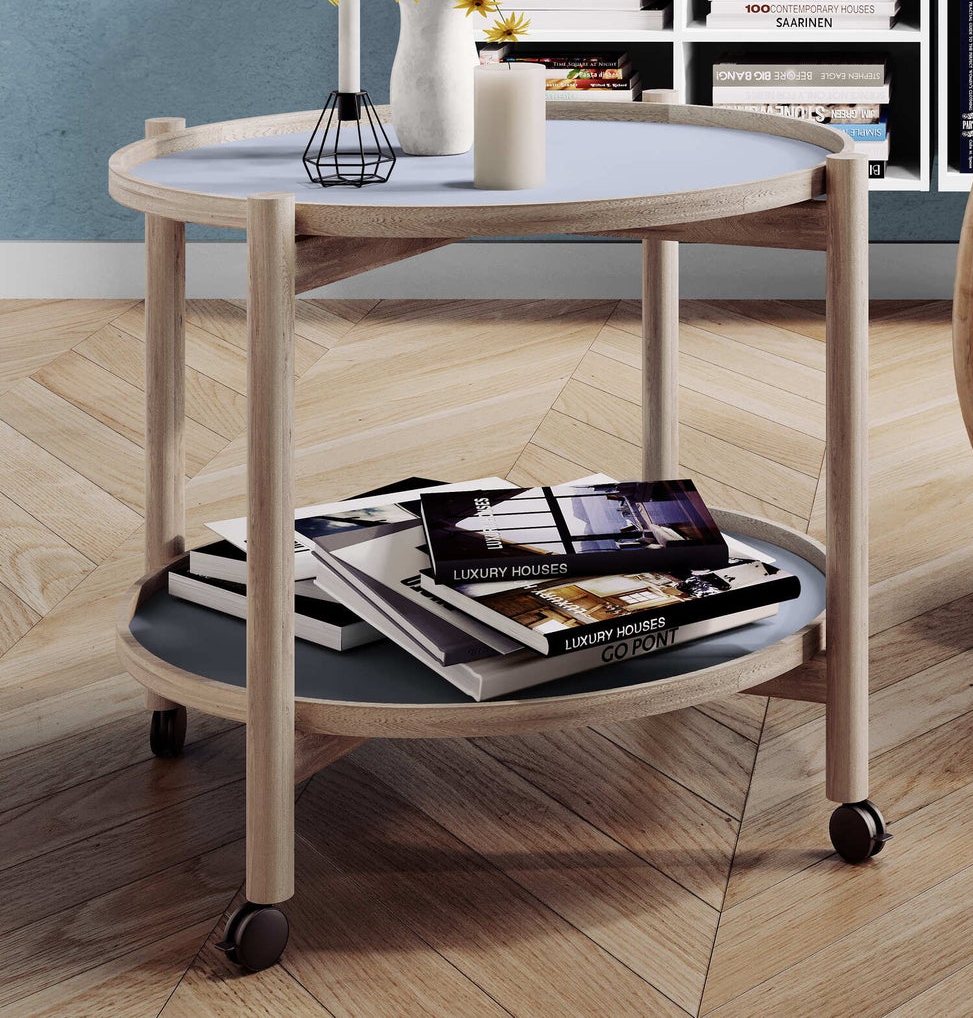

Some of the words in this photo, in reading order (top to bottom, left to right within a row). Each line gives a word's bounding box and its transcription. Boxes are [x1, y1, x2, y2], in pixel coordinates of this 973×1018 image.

[841, 5, 875, 14] HOUSES
[776, 17, 833, 27] SAARINEN
[717, 71, 752, 81] BANG!
[754, 71, 771, 81] BIG
[774, 71, 812, 81] BEFORE
[831, 110, 856, 118] GREEN
[851, 129, 882, 137] SIMPLE
[454, 566, 507, 581] LUXURY
[512, 563, 568, 577] HOUSES
[565, 629, 614, 650] LUXURY
[617, 616, 666, 638] HOUSES
[601, 642, 629, 663] GO
[633, 628, 679, 655] PONT
